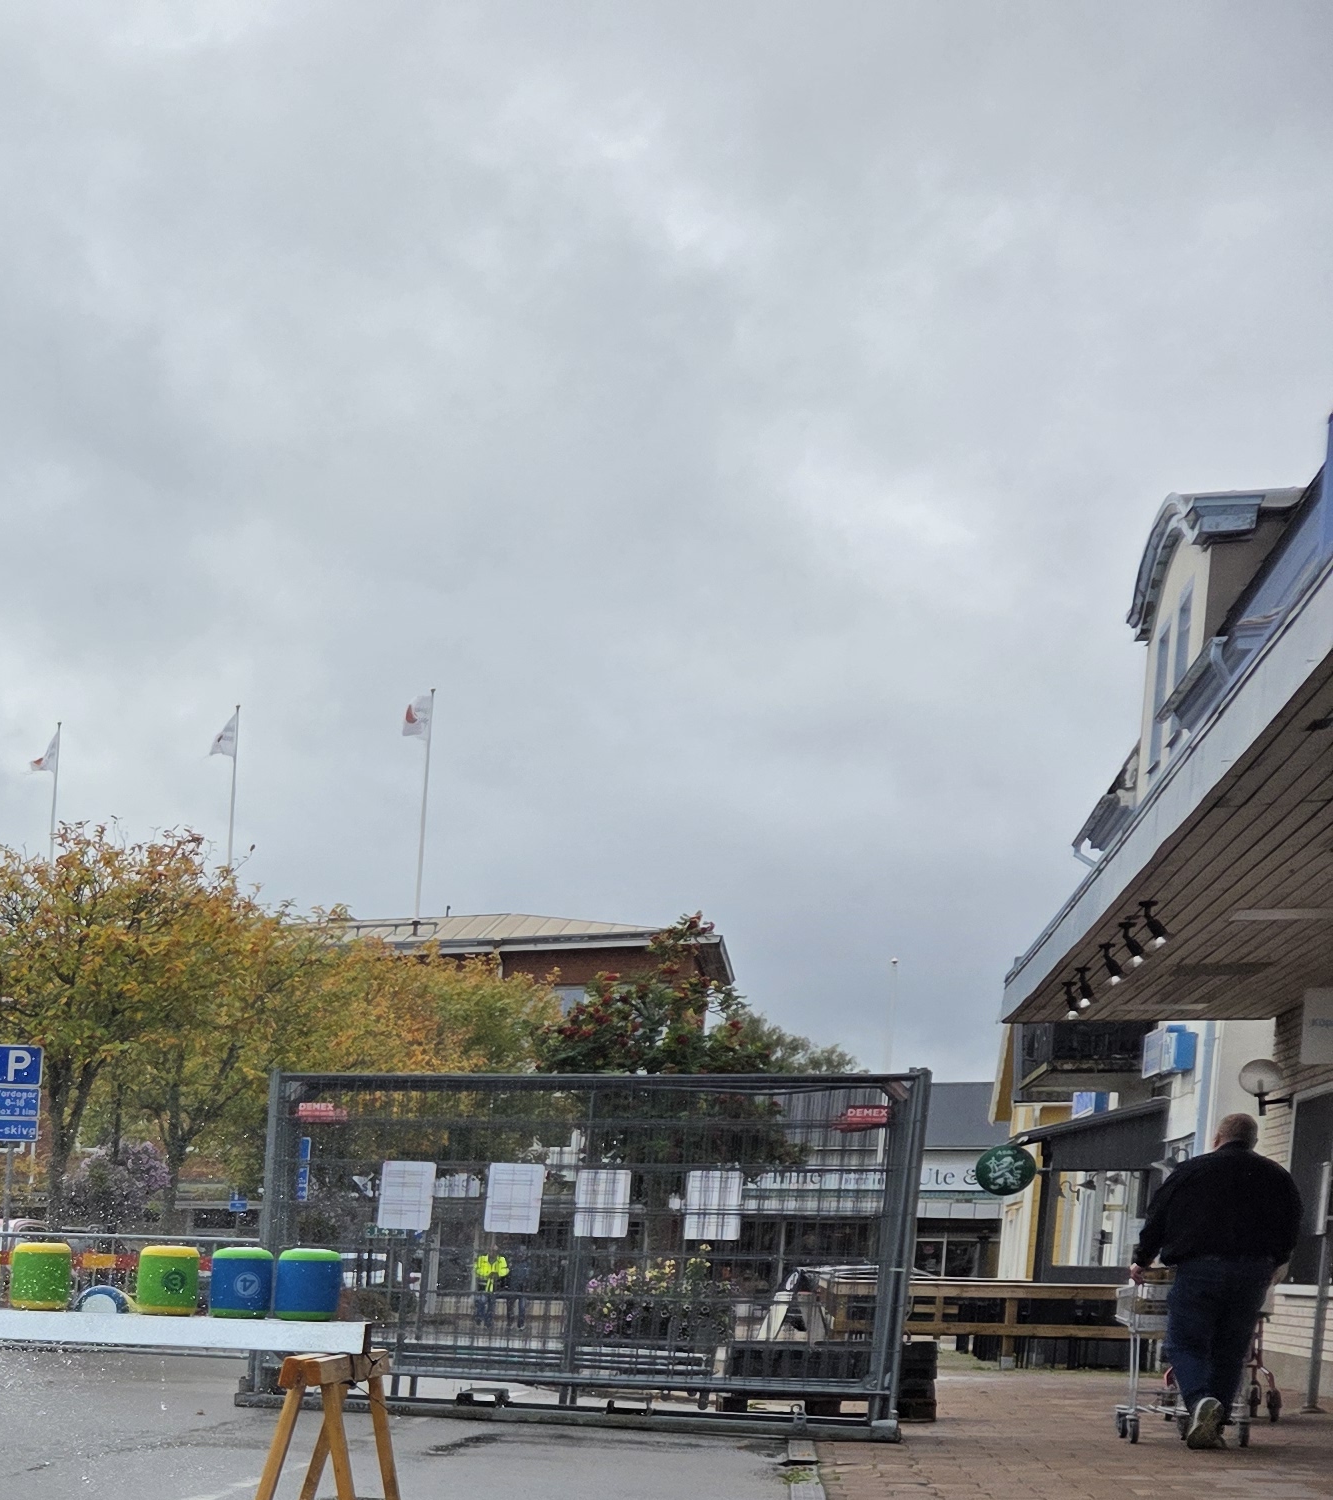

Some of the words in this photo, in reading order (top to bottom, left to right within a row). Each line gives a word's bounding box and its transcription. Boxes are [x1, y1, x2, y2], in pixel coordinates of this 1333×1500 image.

[7, 1049, 32, 1082] P
[298, 1102, 335, 1111] DEMEX
[21, 1108, 37, 1116] tim
[847, 1108, 888, 1117] DEMEX
